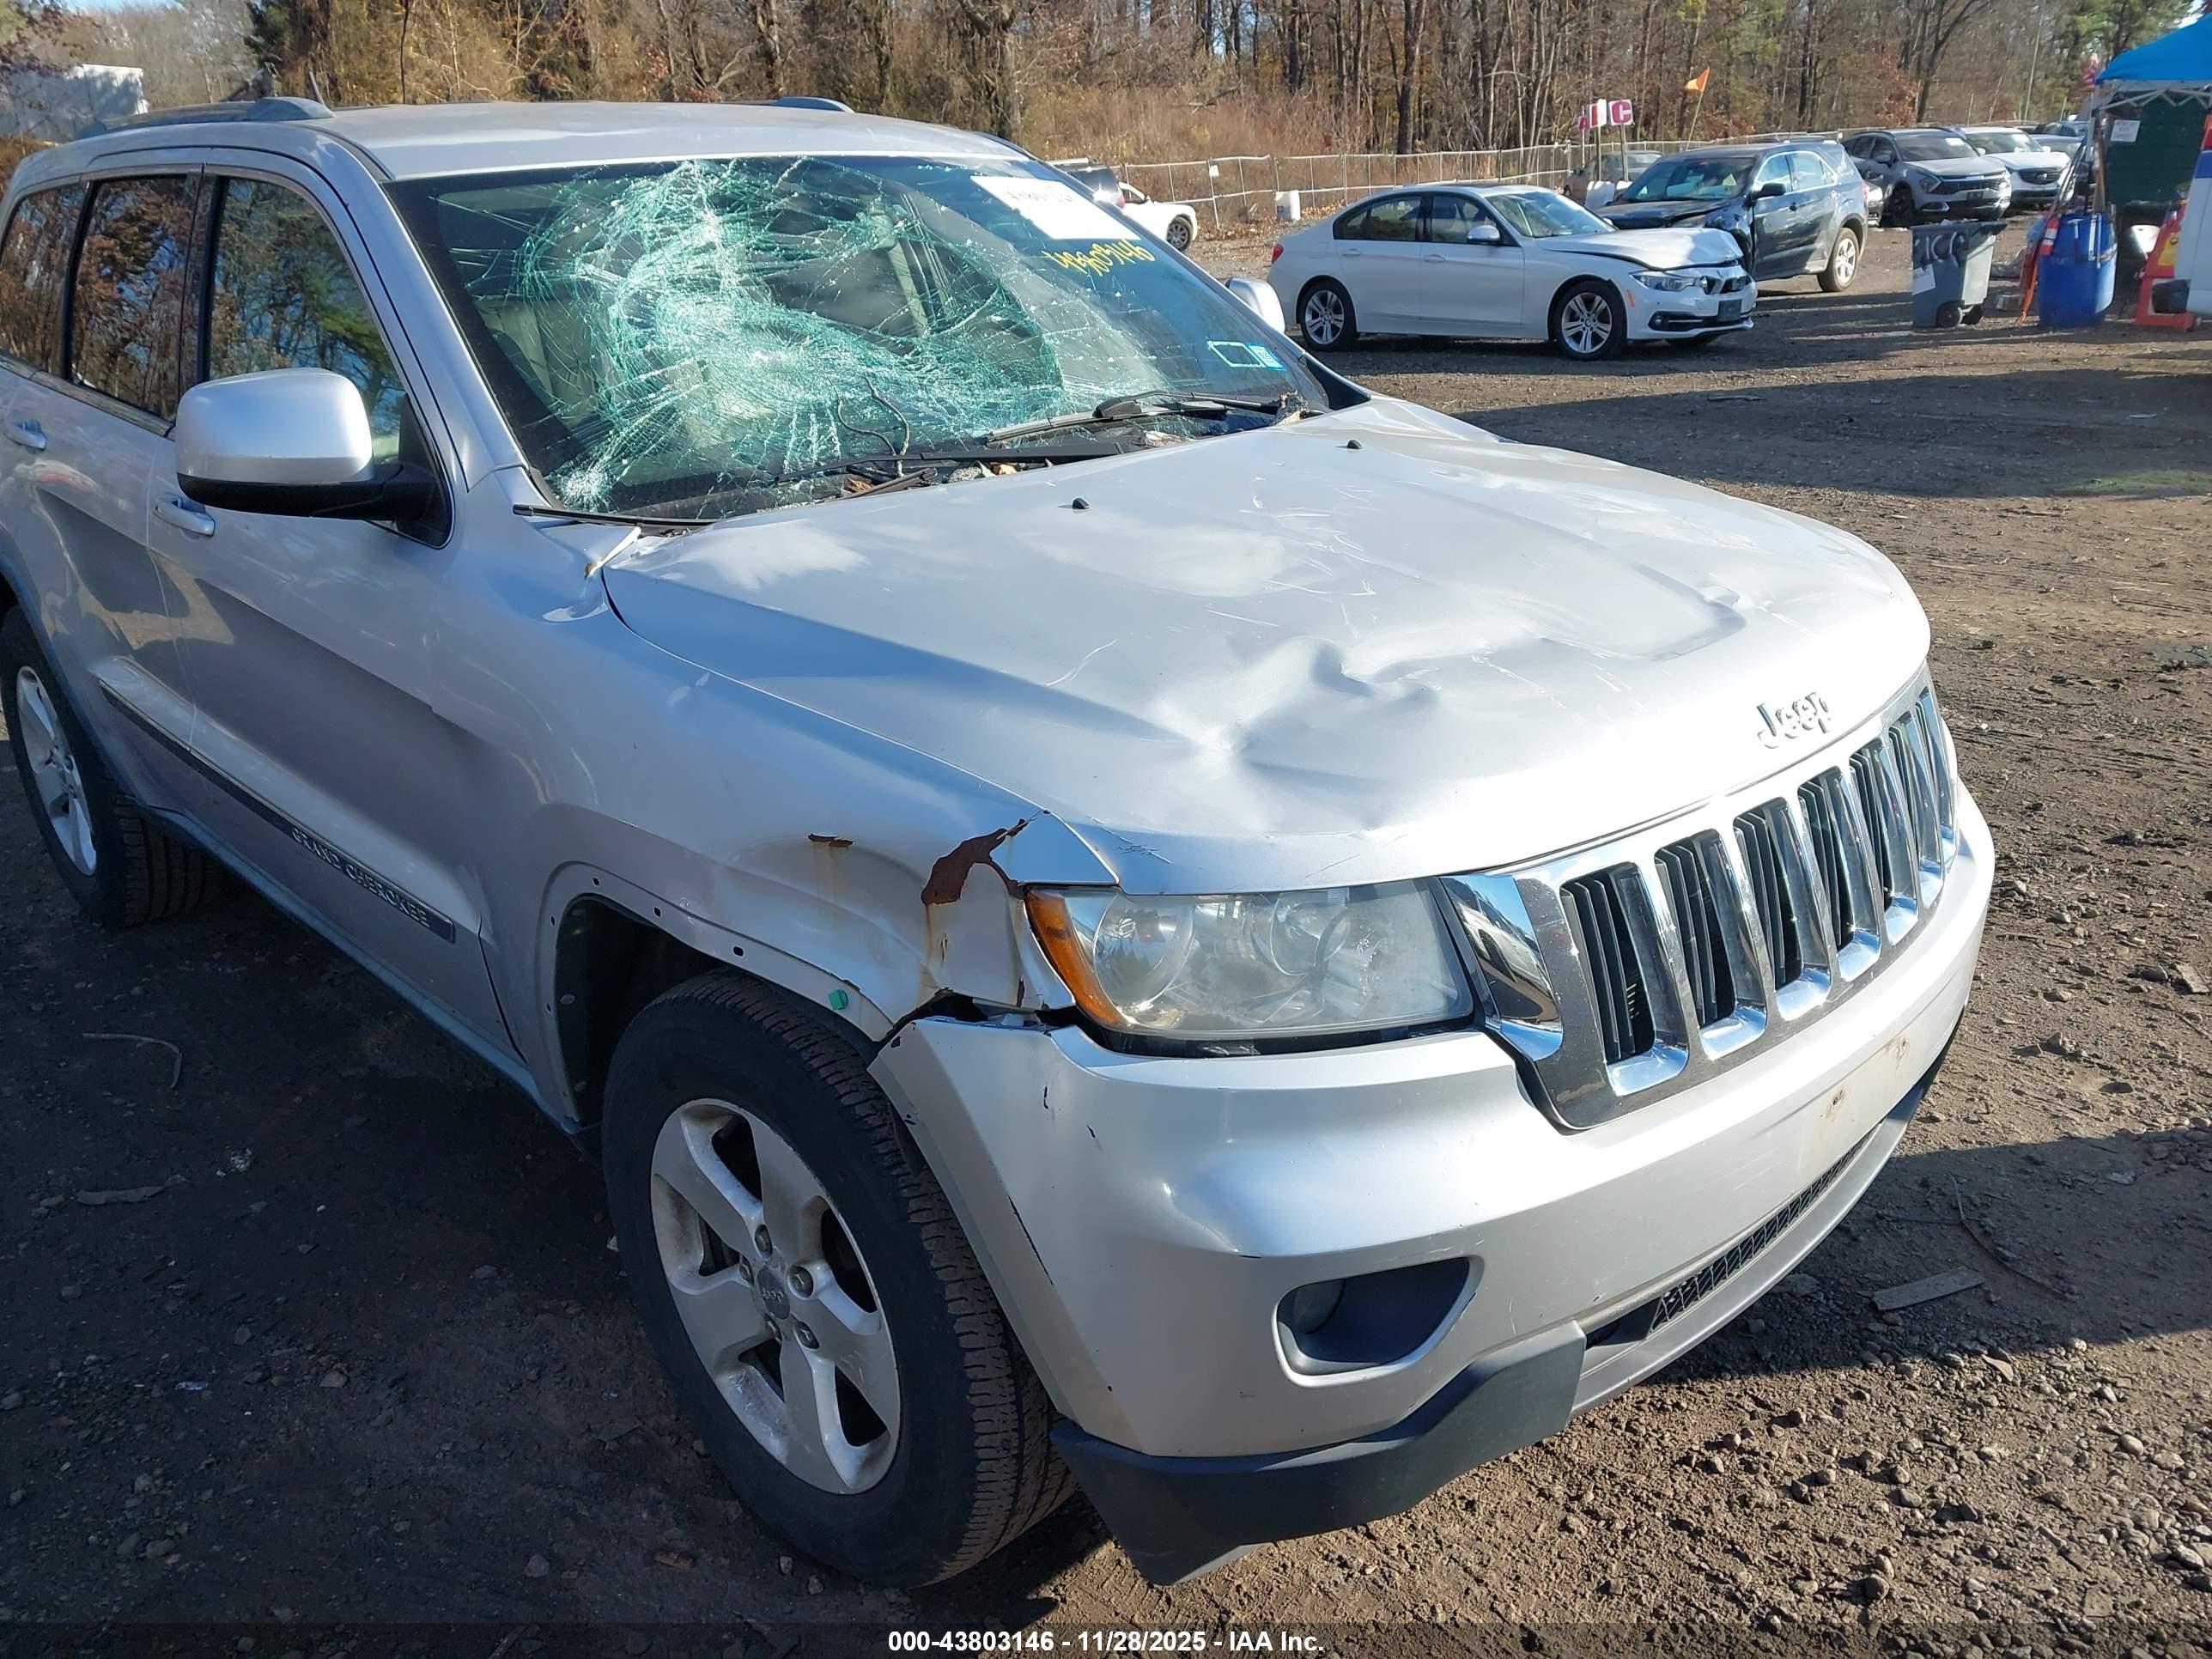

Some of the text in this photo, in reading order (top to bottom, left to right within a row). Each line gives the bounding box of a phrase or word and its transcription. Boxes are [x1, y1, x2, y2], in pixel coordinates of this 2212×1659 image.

[1756, 690, 1832, 750] Jeep
[290, 827, 431, 928] GRAND CHEROKEE
